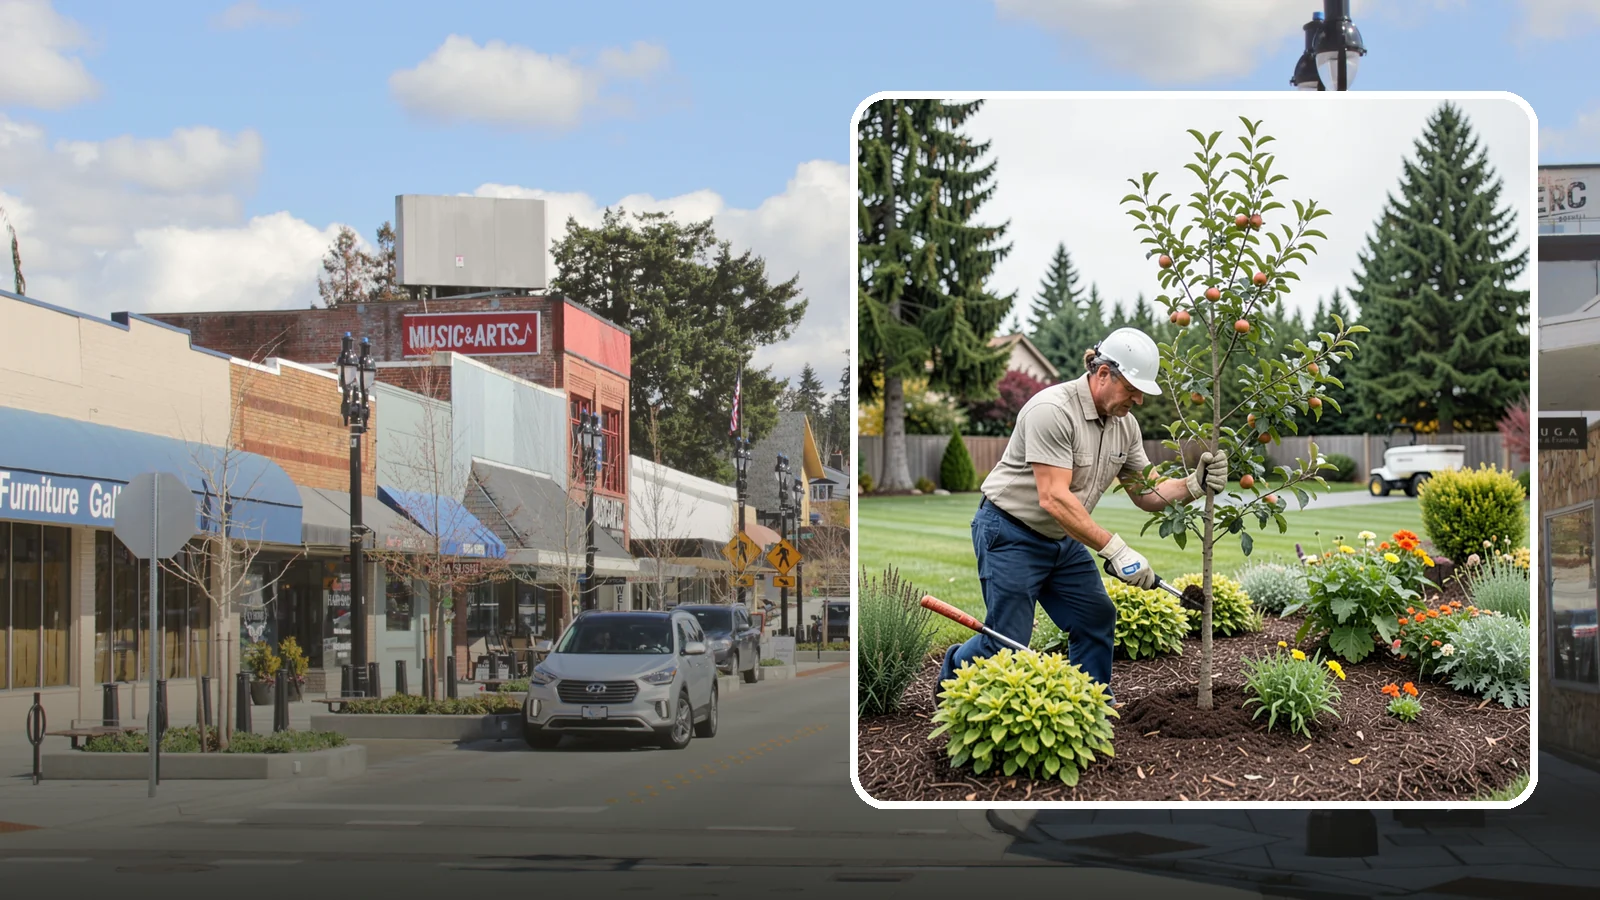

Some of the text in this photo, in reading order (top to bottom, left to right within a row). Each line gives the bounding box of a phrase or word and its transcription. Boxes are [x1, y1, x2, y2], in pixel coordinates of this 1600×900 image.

[1540, 428, 1577, 436] UGA
[0, 471, 121, 519] Furniture Gal
[453, 563, 479, 574] SUSHI
